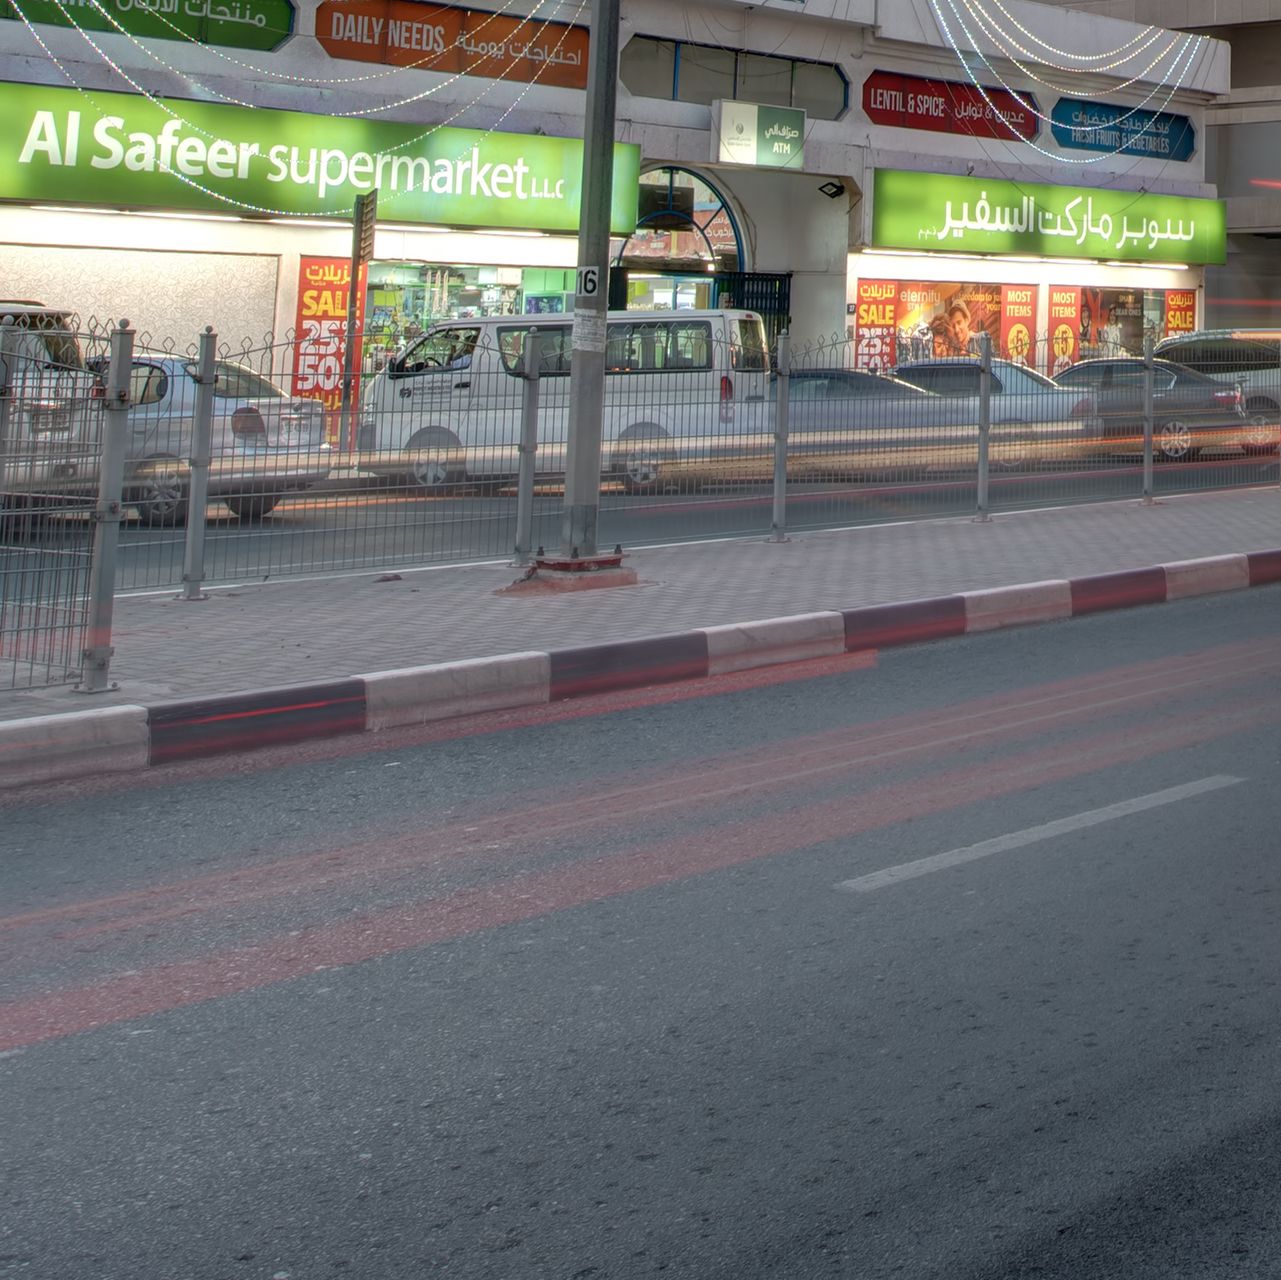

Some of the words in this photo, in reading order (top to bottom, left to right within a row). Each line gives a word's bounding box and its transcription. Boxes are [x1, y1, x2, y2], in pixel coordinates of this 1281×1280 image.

[331, 11, 385, 45] DAILY
[387, 19, 446, 53] NEEDS
[870, 87, 905, 112] LENTIL
[907, 94, 915, 113] &
[916, 95, 946, 118] SPICE
[954, 101, 984, 120] توابل
[772, 141, 791, 154] ATM
[1071, 127, 1095, 145] FRESH
[1096, 129, 1121, 148] FRUITS
[18, 110, 81, 167] Al
[90, 115, 260, 179] Safeer
[266, 142, 530, 200] supermarket
[937, 190, 1035, 240] السفير
[1038, 195, 1113, 245] ماركت
[1116, 215, 1195, 250] سوبر
[578, 269, 597, 295] 16
[899, 288, 941, 305] eternity
[1007, 290, 1032, 303] MOST
[1052, 292, 1076, 304] MOST
[858, 303, 895, 326] SALE
[1006, 305, 1032, 317] ITEMS
[1051, 306, 1077, 318] ITEMS
[1167, 310, 1193, 328] SALE
